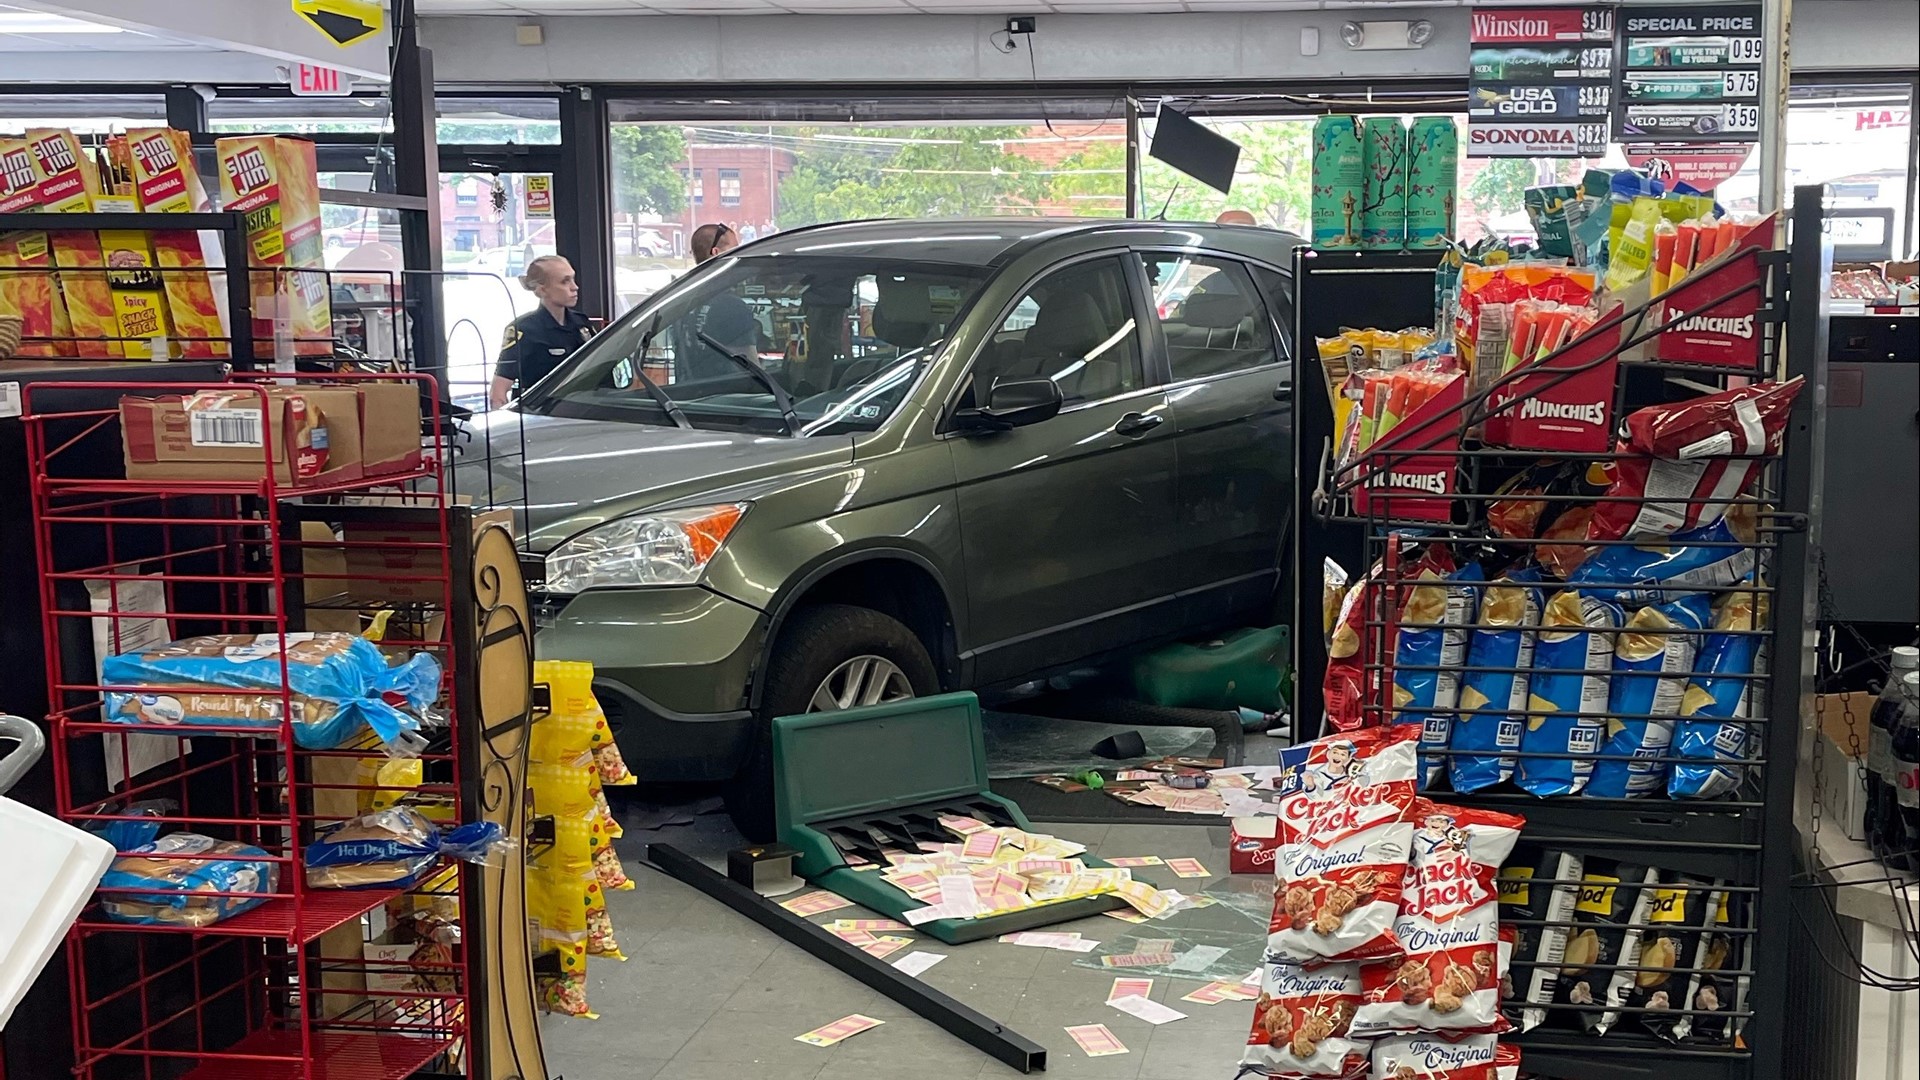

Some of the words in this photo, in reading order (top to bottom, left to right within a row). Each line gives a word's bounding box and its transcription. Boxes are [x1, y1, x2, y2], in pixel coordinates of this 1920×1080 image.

[1473, 14, 1549, 37] Winston
[1627, 18, 1697, 31] SPECIAL
[1702, 17, 1753, 30] PRICE
[1682, 48, 1702, 56] VAPE
[1703, 47, 1726, 56] THAT
[1510, 88, 1555, 101] USA
[1498, 101, 1557, 114] GOLD
[1631, 117, 1656, 126] VELO
[1471, 129, 1575, 144] SONOMA
[43, 178, 79, 196] ORIGINAL
[144, 178, 181, 196] ORIGINAL
[1375, 208, 1402, 217] Green
[1421, 207, 1437, 216] Tea
[121, 308, 156, 325] SNACK
[1666, 307, 1754, 339] MUNCHIES
[124, 320, 158, 337] STICK
[1521, 397, 1605, 425] MUNCHIES
[191, 696, 230, 712] Round
[234, 698, 252, 717] Top
[338, 844, 358, 856] Hot
[362, 843, 385, 857] Dog
[1295, 845, 1366, 876] Original
[1406, 880, 1473, 916] Jack
[1397, 921, 1416, 939] The
[1409, 923, 1481, 950] Original
[1272, 965, 1288, 981] The
[1279, 974, 1349, 998] Original
[1409, 1040, 1431, 1056] The
[1425, 1041, 1494, 1070] Original
